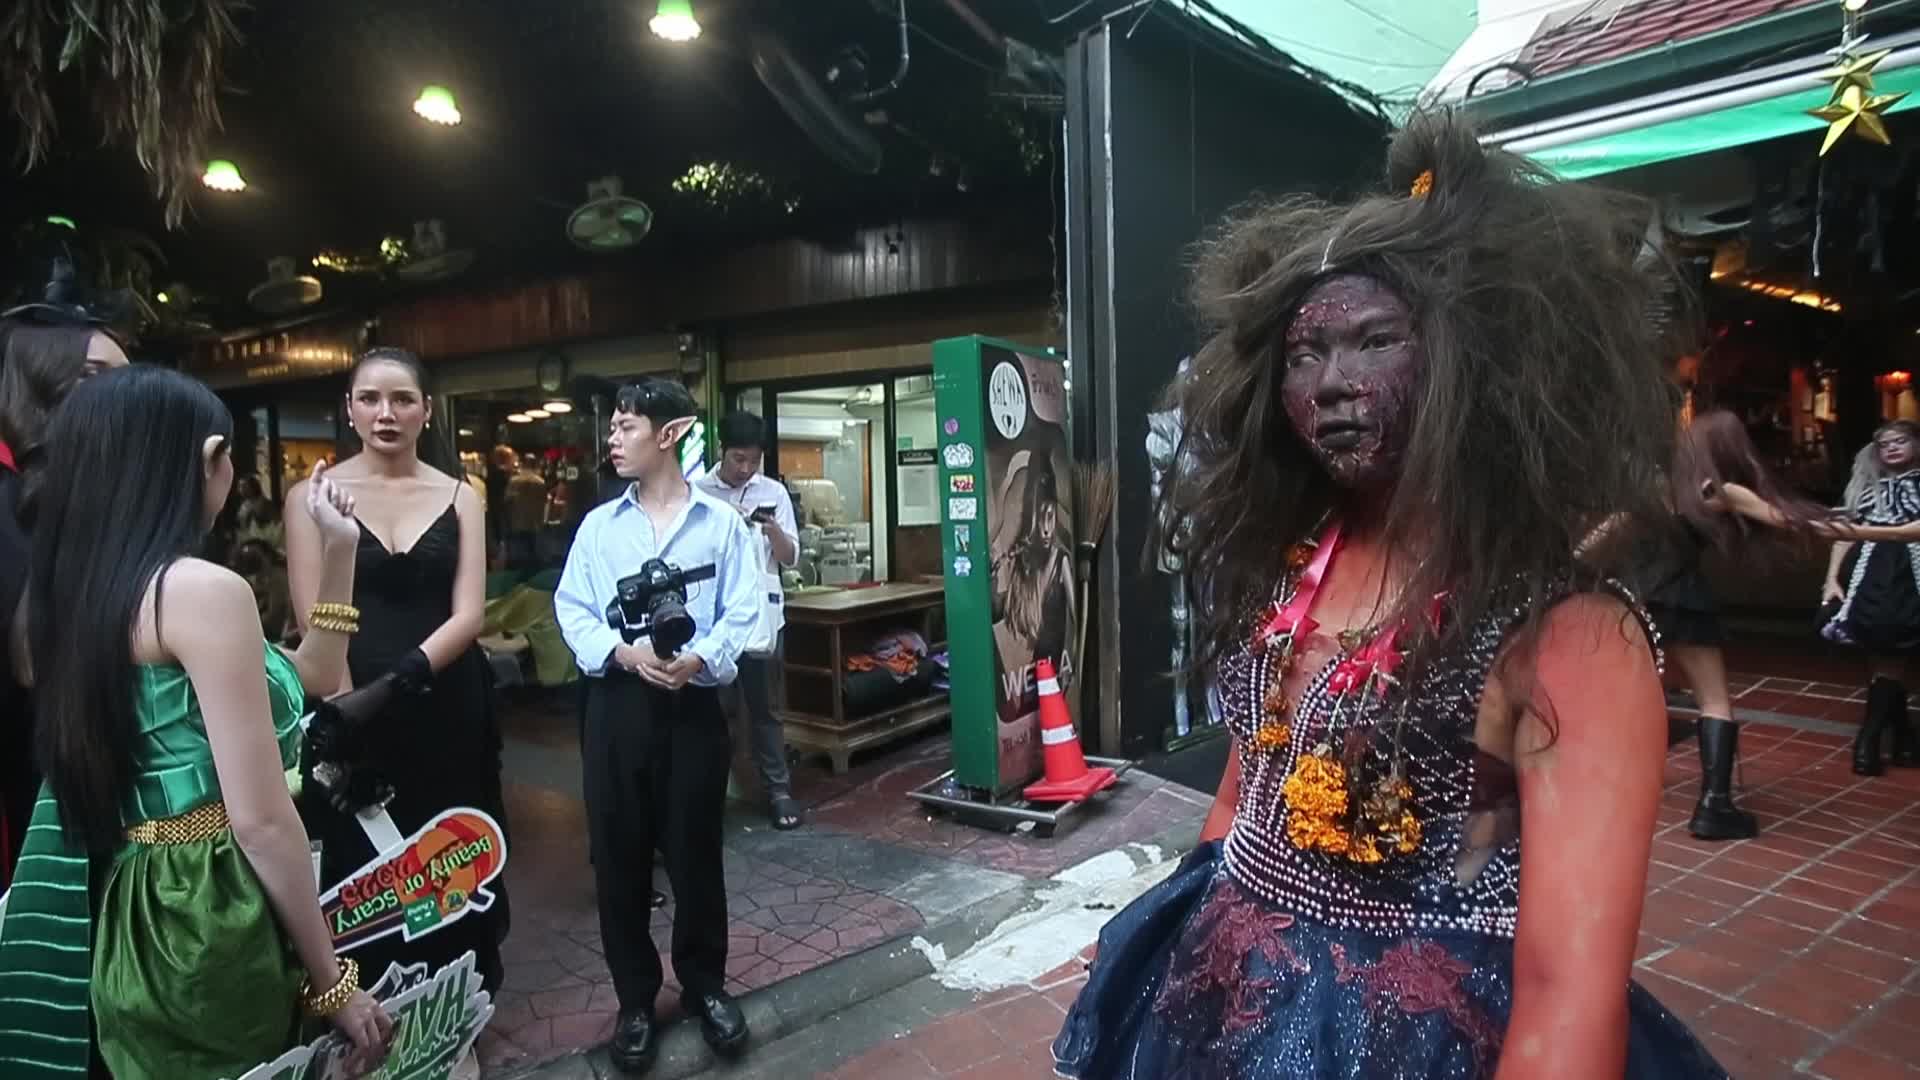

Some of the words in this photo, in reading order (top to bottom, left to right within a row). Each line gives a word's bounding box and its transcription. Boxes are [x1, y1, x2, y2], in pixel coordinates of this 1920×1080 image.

[1002, 649, 1073, 702] WEA
[427, 836, 493, 882] Beauty
[405, 872, 425, 894] or
